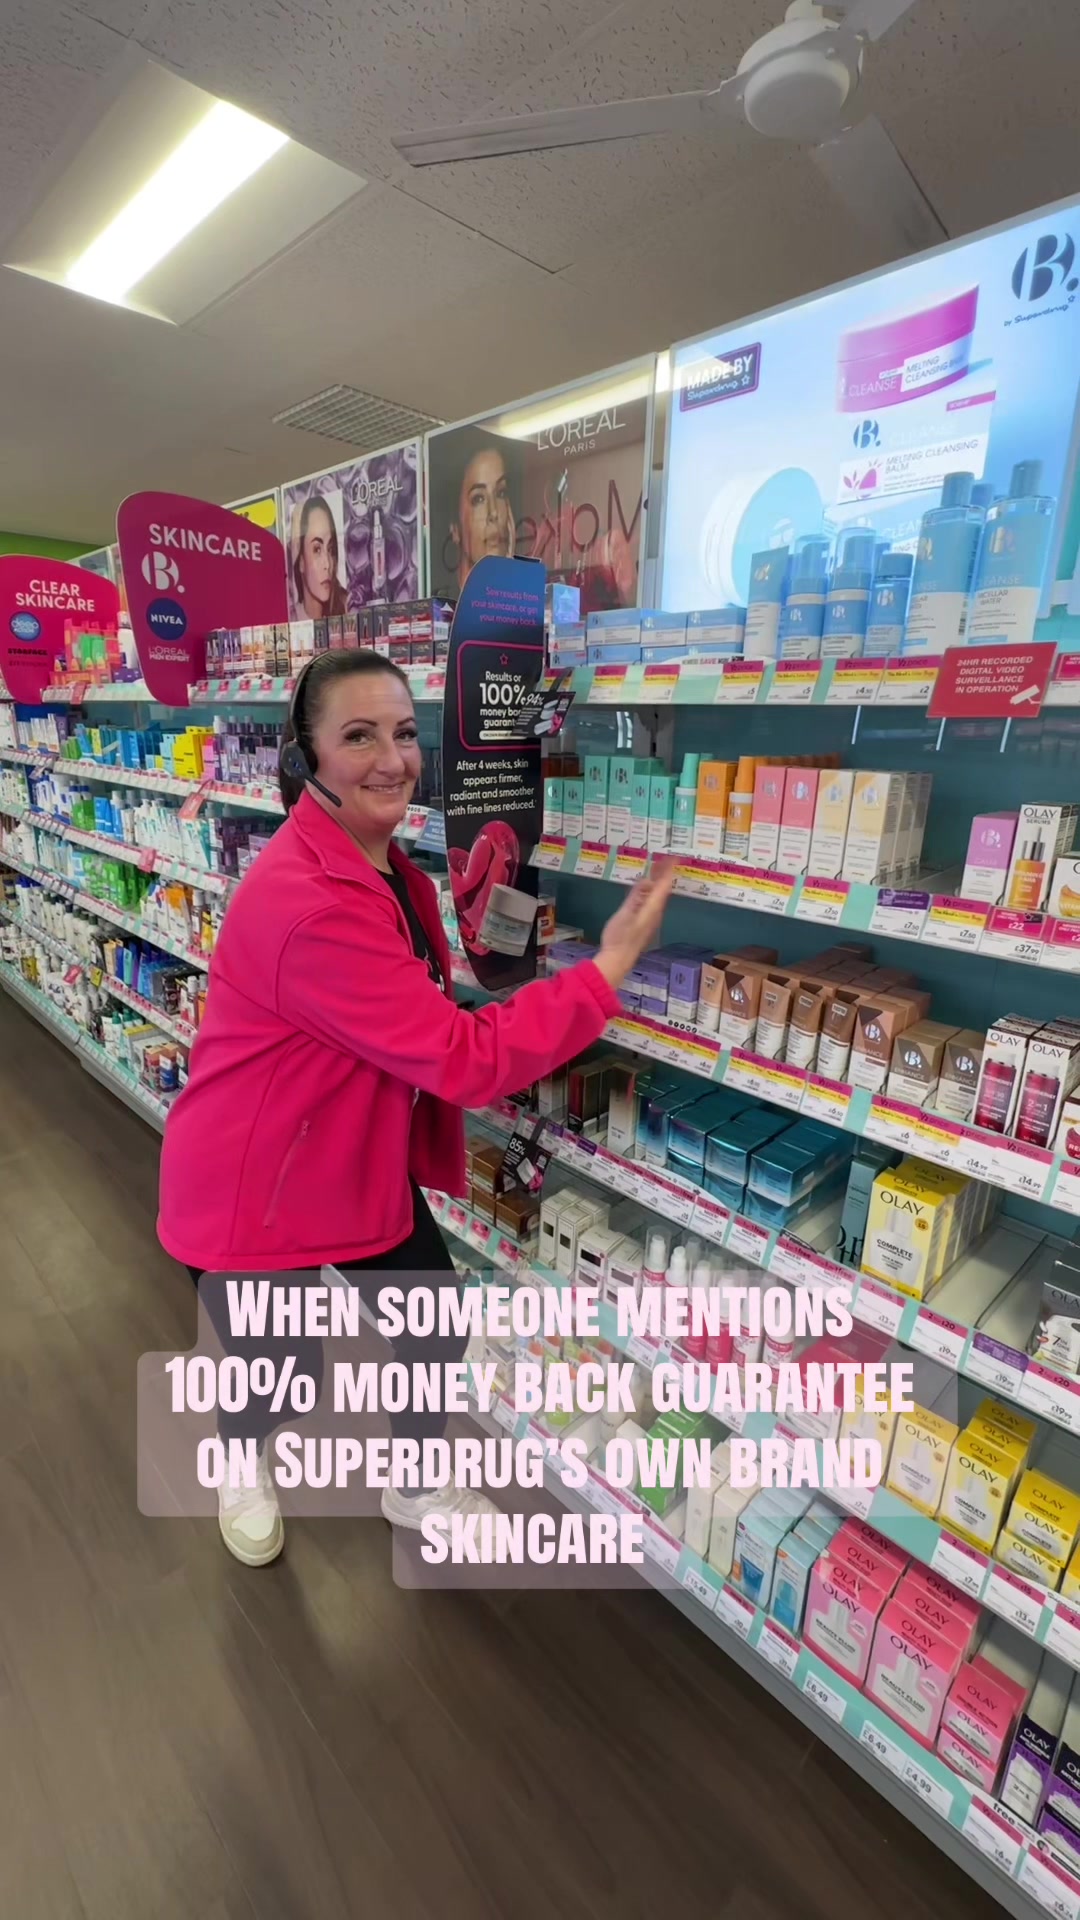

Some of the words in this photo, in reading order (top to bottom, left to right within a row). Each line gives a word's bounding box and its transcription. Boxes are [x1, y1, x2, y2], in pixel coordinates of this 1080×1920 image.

[733, 353, 754, 377] BY
[906, 355, 940, 374] MELTING
[563, 439, 596, 456] PARIS
[149, 523, 262, 562] SKINCARE
[29, 579, 80, 597] CLEAR
[15, 592, 95, 612] SKINCARE
[150, 612, 184, 625] NIVEA
[956, 658, 979, 667] 24HR
[981, 656, 1034, 666] RECORDED
[960, 667, 994, 676] DIGITAL
[995, 665, 1025, 674] VIDEO
[485, 670, 511, 683] Results
[512, 674, 522, 683] or
[955, 675, 1025, 685] SURVEILLANCE
[479, 682, 526, 706] 100%
[955, 685, 965, 694] IN
[966, 684, 1020, 694] OPERATION
[479, 708, 505, 721] money
[456, 759, 477, 771] After
[478, 760, 485, 770] 4
[513, 758, 529, 769] skin
[463, 775, 498, 787] appears
[450, 789, 480, 802] radiant
[482, 787, 498, 800] and
[499, 784, 535, 799] smoother
[447, 803, 466, 817] with
[467, 802, 482, 815] fine
[482, 801, 502, 814] lines
[1023, 807, 1058, 819] OLAY
[1026, 818, 1051, 826] SERUMS
[1008, 922, 1025, 931] £22
[990, 1032, 1021, 1047] OLAY
[1032, 1043, 1065, 1058] OLAY
[509, 1137, 526, 1156] 85%
[880, 1190, 924, 1216] OLAY
[876, 1238, 913, 1260] COMPLETE
[1051, 1289, 1080, 1308] OLA
[1054, 1376, 1070, 1388] £20
[905, 1423, 941, 1449] OLAY
[982, 1424, 1012, 1445] OLAY
[969, 1442, 1001, 1464] OLAY
[958, 1456, 999, 1484] OLAY
[1032, 1488, 1065, 1511] OLAY
[1024, 1511, 1059, 1536] OLAY
[861, 1526, 890, 1551] OLAY
[847, 1546, 880, 1573] OLAY
[1012, 1541, 1047, 1567] OLAY
[833, 1566, 865, 1593] OLAY
[926, 1575, 957, 1603] OLAY
[822, 1581, 861, 1614] OLAY
[915, 1597, 950, 1626] OLAY
[901, 1619, 937, 1650] OLAY
[890, 1635, 933, 1671] OLAY
[805, 1679, 829, 1703] £6.49
[967, 1685, 998, 1711] OLAY
[957, 1710, 988, 1737] OLAY
[862, 1728, 888, 1755] £6.49
[1023, 1727, 1050, 1750] OLAY
[951, 1741, 982, 1769] OLAY
[905, 1766, 933, 1795] £4.99
[992, 1802, 1016, 1826] free
